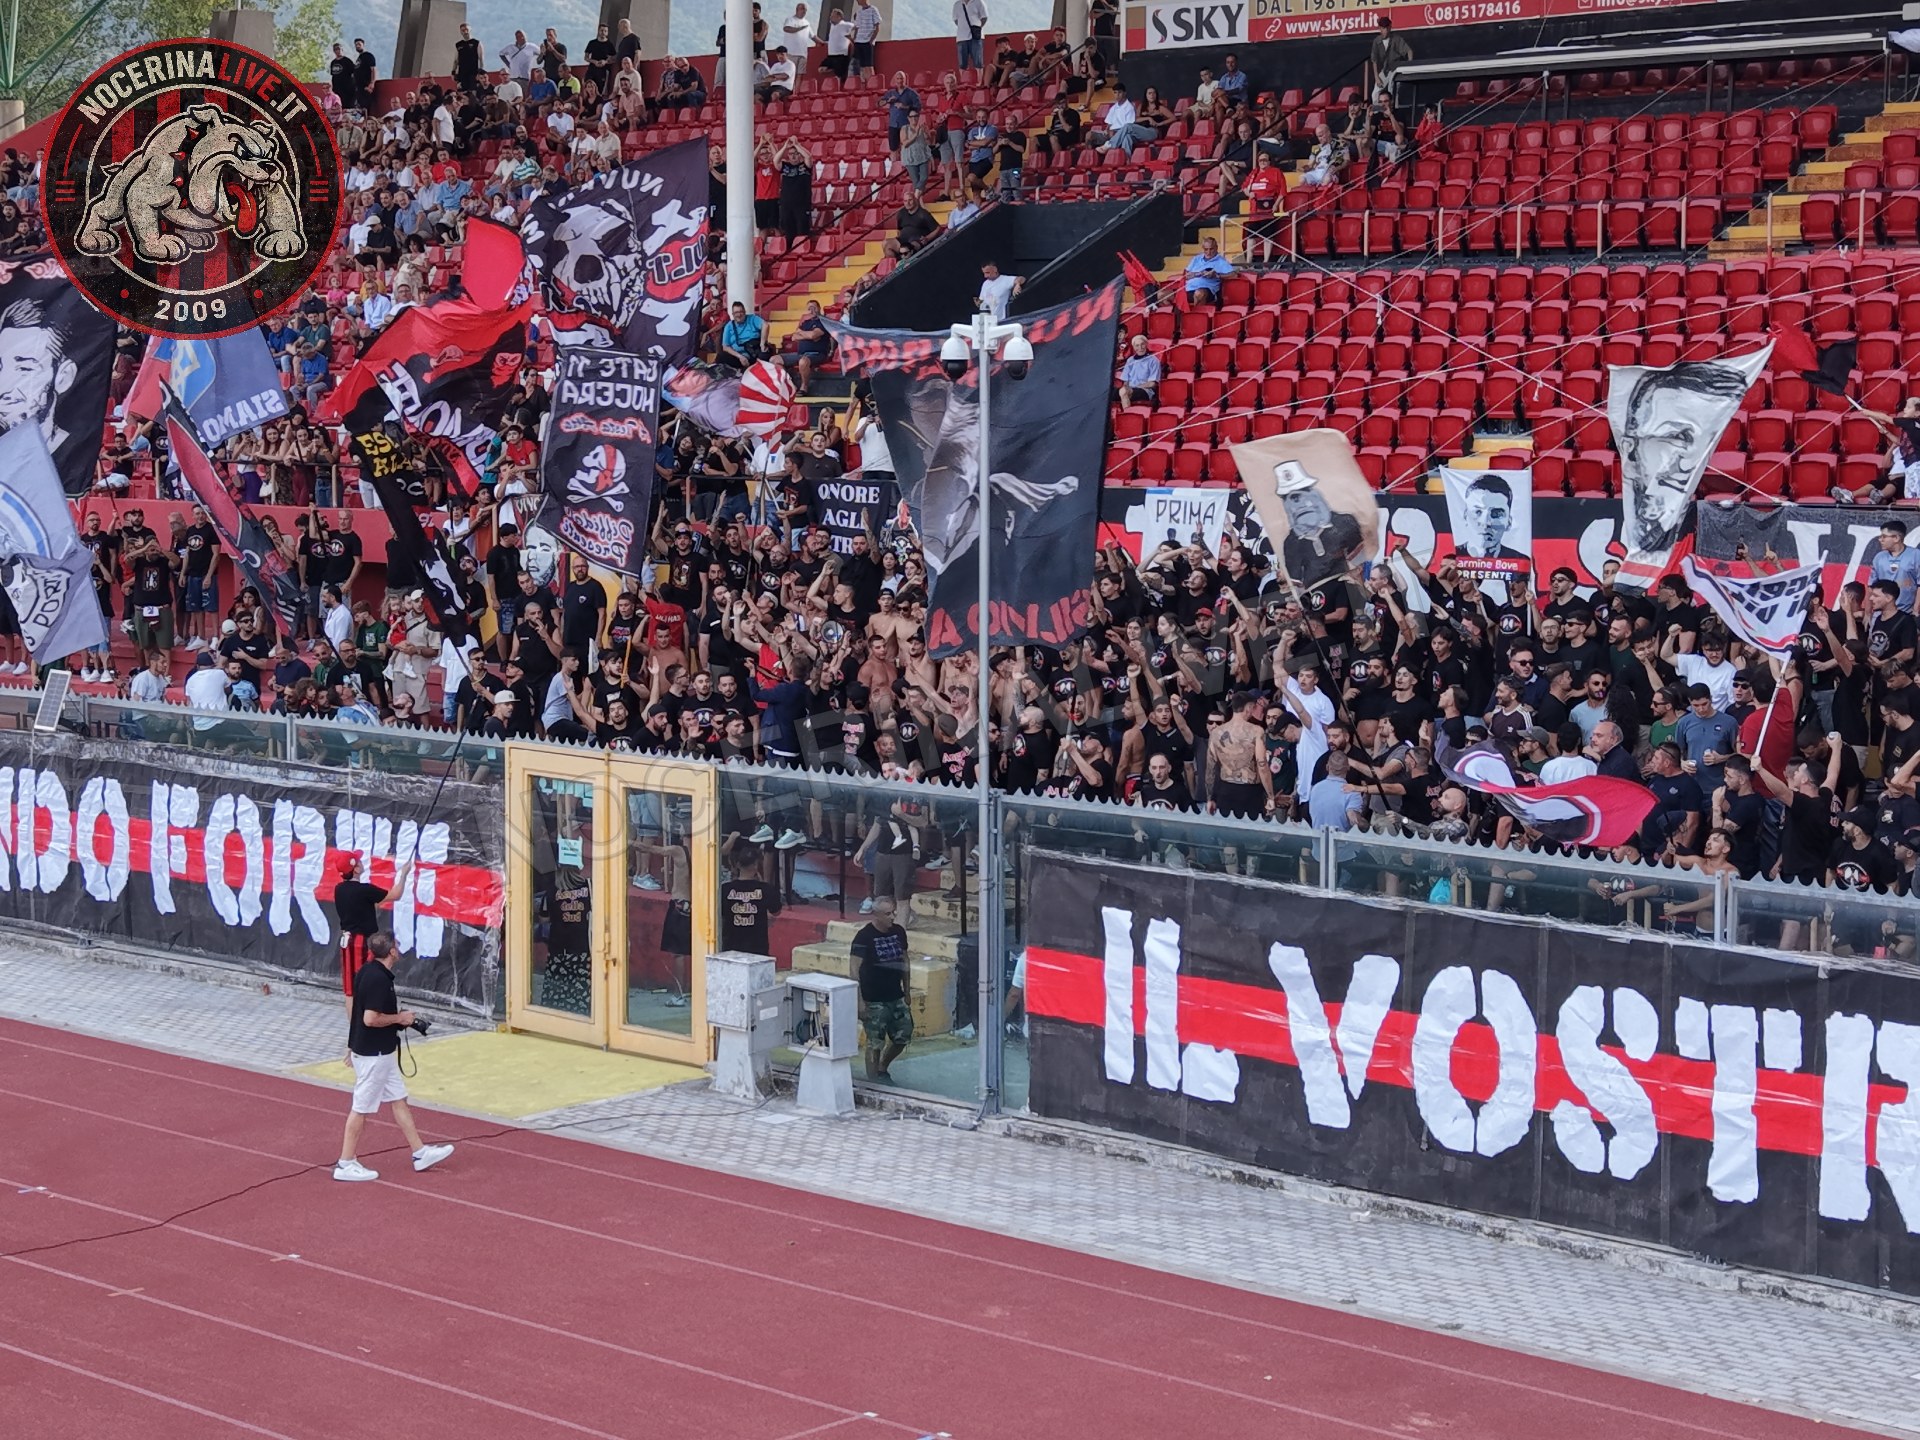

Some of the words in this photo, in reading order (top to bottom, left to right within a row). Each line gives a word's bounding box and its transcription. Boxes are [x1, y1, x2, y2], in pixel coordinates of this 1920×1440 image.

[1435, 1, 1521, 21] 0815178416
[1286, 12, 1379, 34] www.skysrl.it
[818, 482, 880, 504] ONORE
[1156, 499, 1216, 526] PRIMA
[1457, 558, 1493, 569] armine
[1457, 570, 1513, 581] PRESENTE
[150, 778, 451, 960] FORTE
[728, 888, 762, 901] Angeli
[734, 914, 755, 926] Sud
[1101, 906, 1241, 1103] IL
